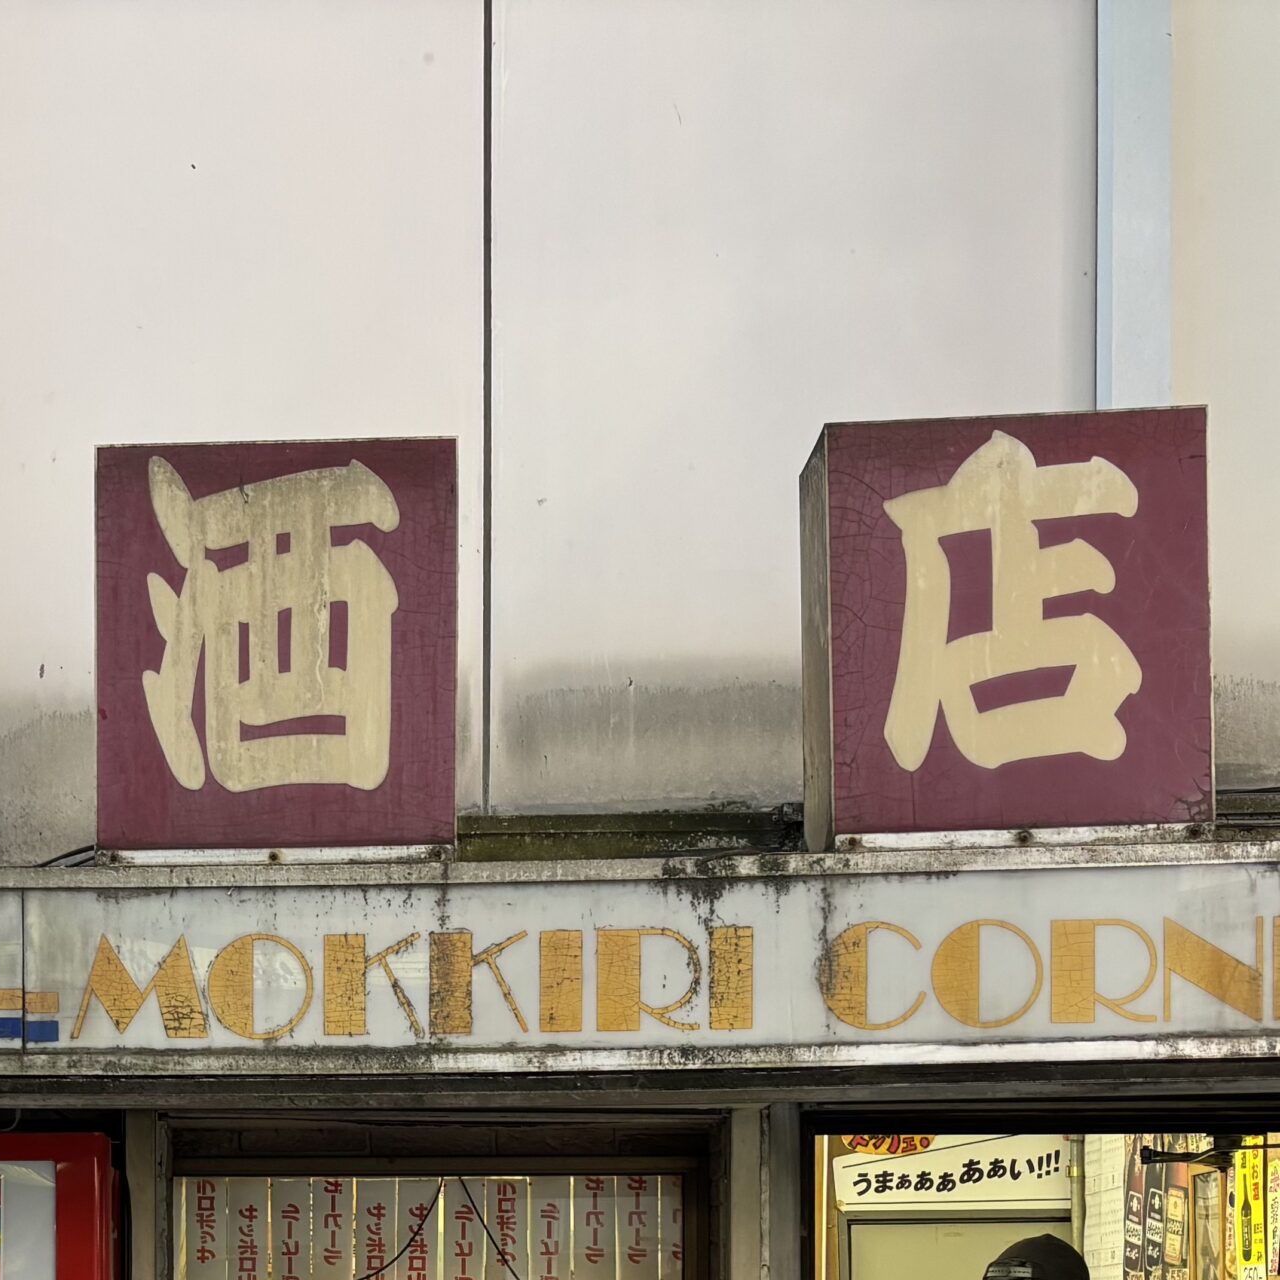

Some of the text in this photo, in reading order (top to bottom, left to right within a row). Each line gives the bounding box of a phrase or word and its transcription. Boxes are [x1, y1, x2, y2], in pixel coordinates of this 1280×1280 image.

[141, 453, 401, 793] 酒
[882, 428, 1143, 771] 店
[71, 914, 1280, 1041] MOKKIRI CORN
